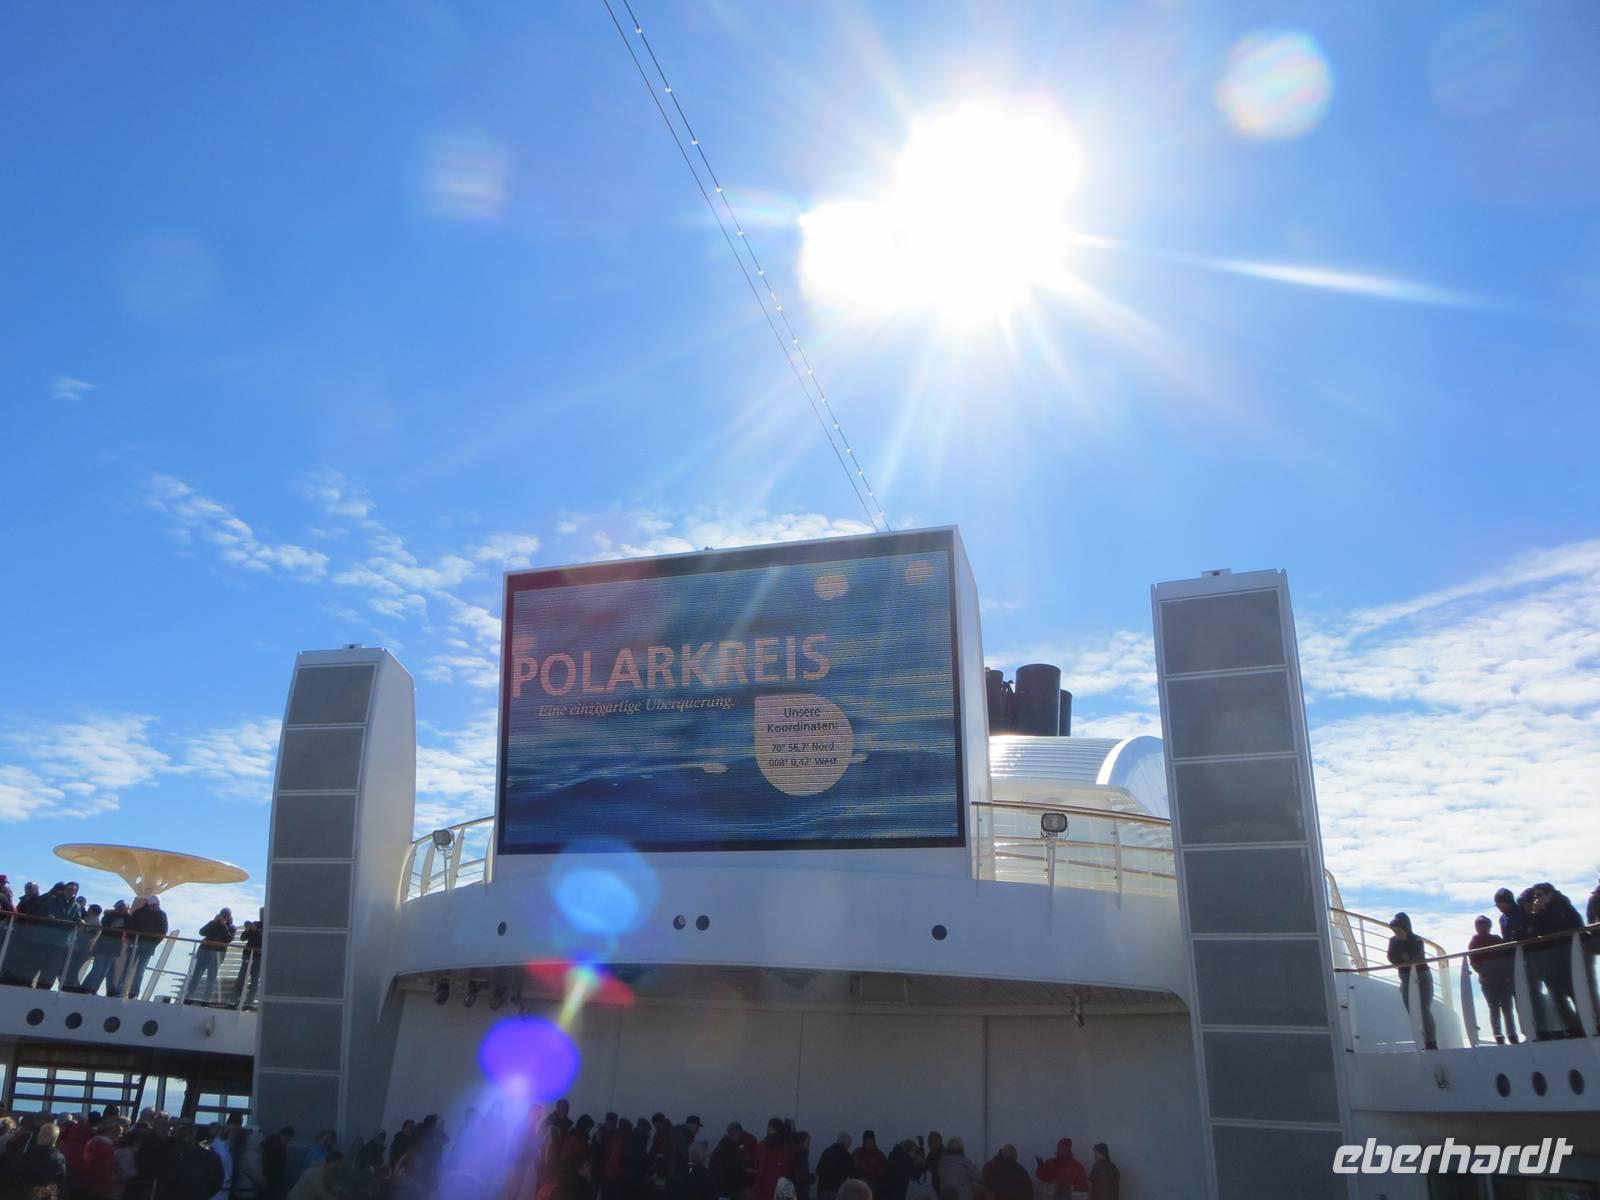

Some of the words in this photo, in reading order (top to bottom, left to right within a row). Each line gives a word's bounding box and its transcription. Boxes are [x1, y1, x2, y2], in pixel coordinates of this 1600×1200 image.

[511, 633, 831, 699] POLARKREIS
[569, 701, 640, 717] einzigartige
[784, 708, 821, 718] Unsere
[767, 721, 839, 733] Koordinaten:
[812, 742, 835, 751] Nord
